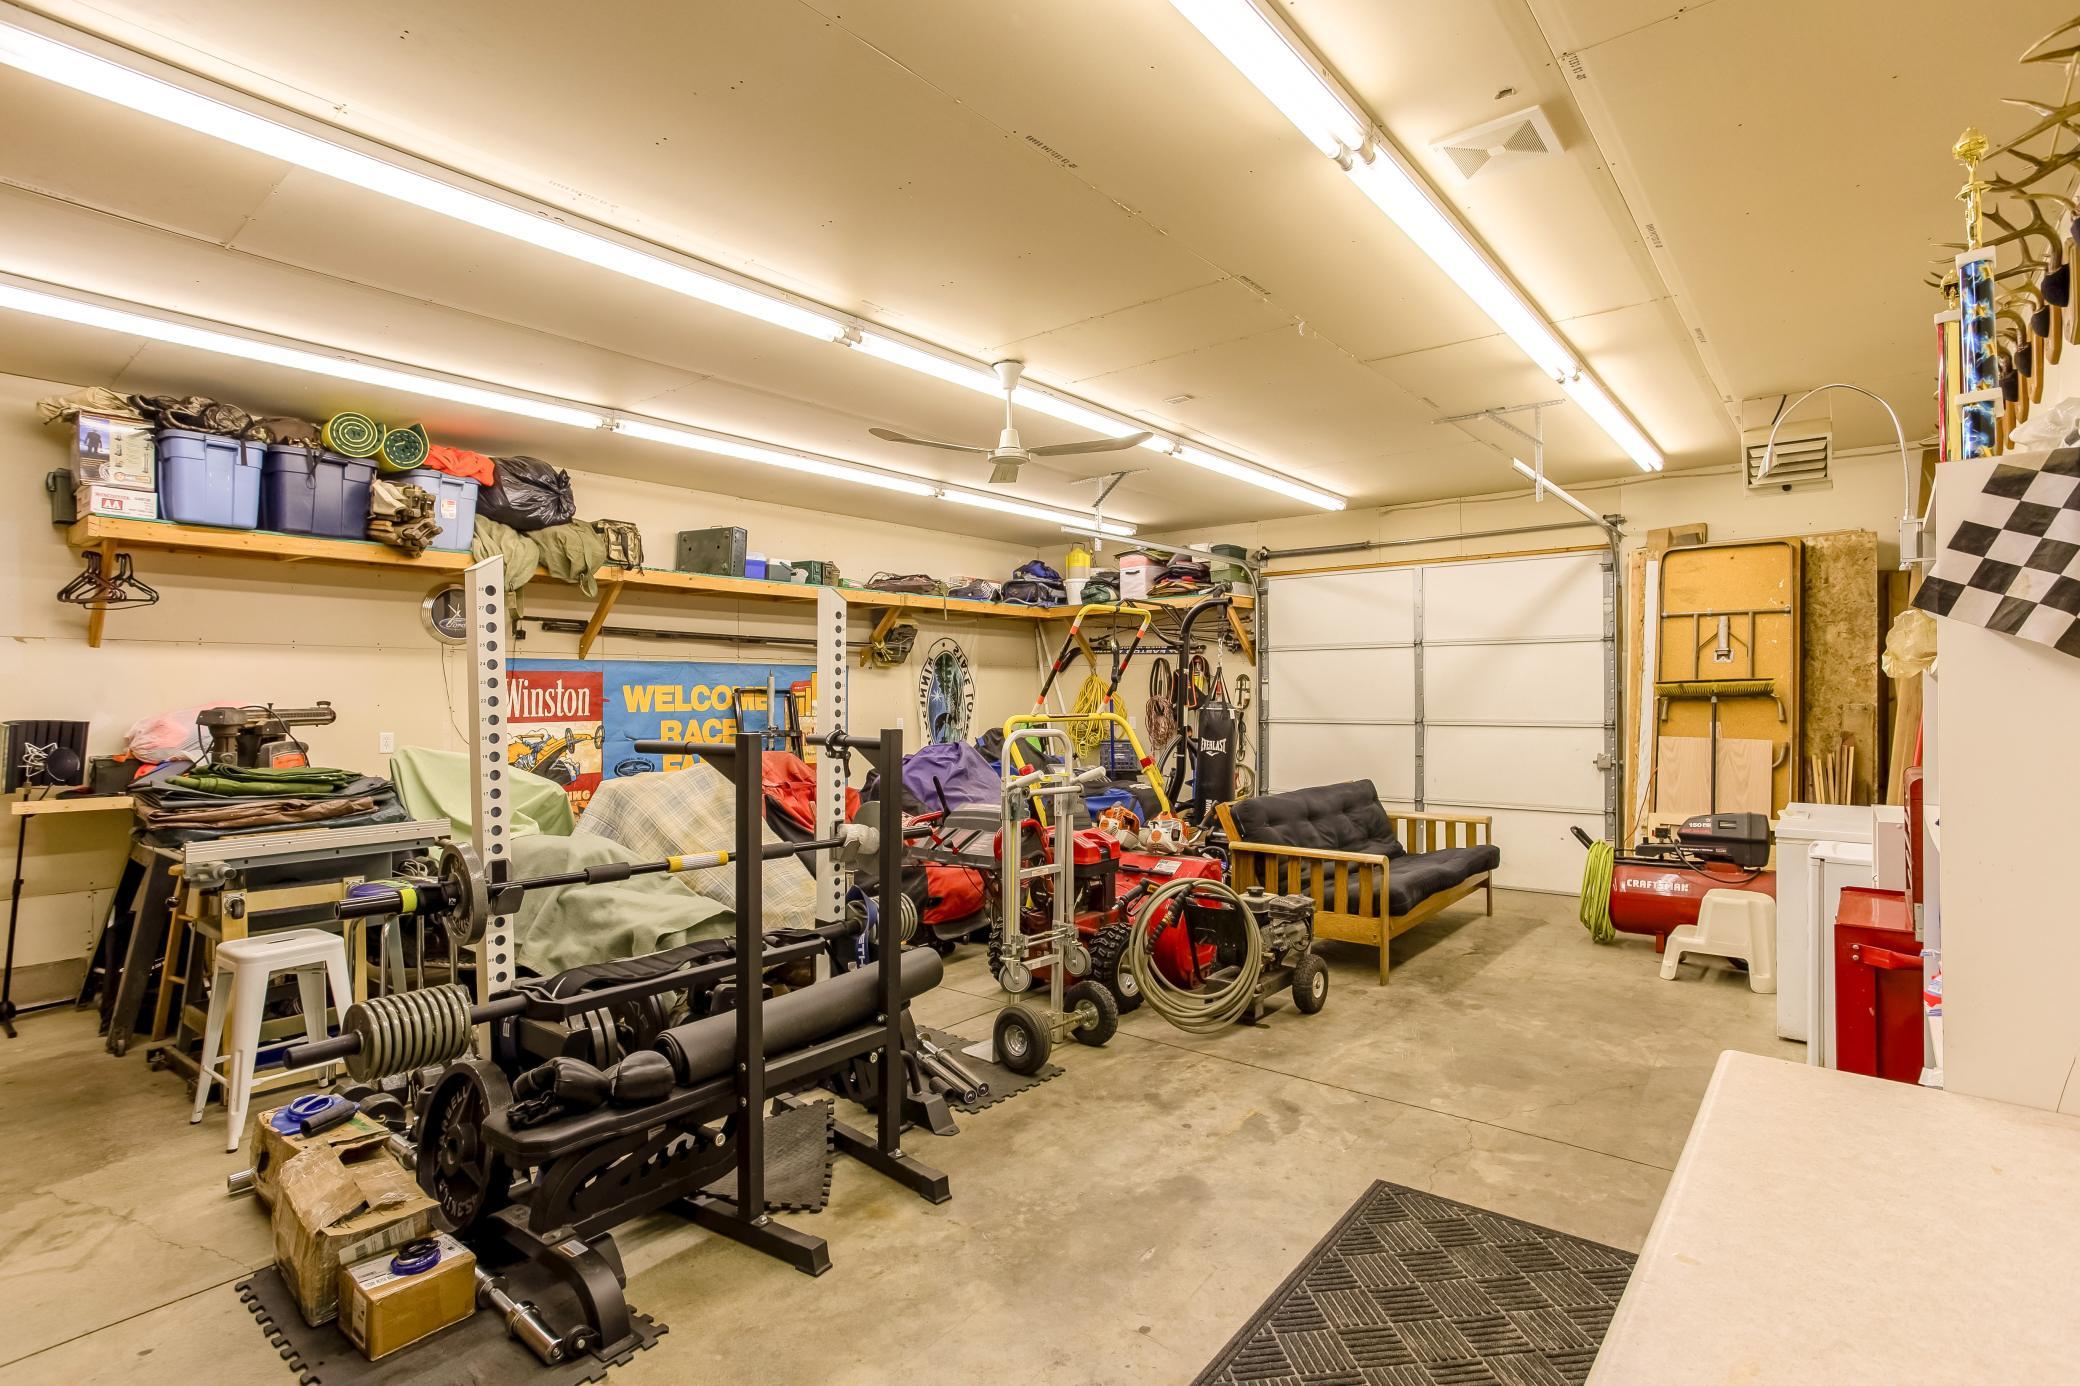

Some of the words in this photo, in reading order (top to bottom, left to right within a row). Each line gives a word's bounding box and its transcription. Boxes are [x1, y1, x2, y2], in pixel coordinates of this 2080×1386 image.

[505, 678, 591, 718] Winston
[660, 718, 737, 744] RACE
[1200, 736, 1227, 754] EVERLAST
[568, 789, 591, 801] ING
[1626, 878, 1689, 893] CRAFTSMAN
